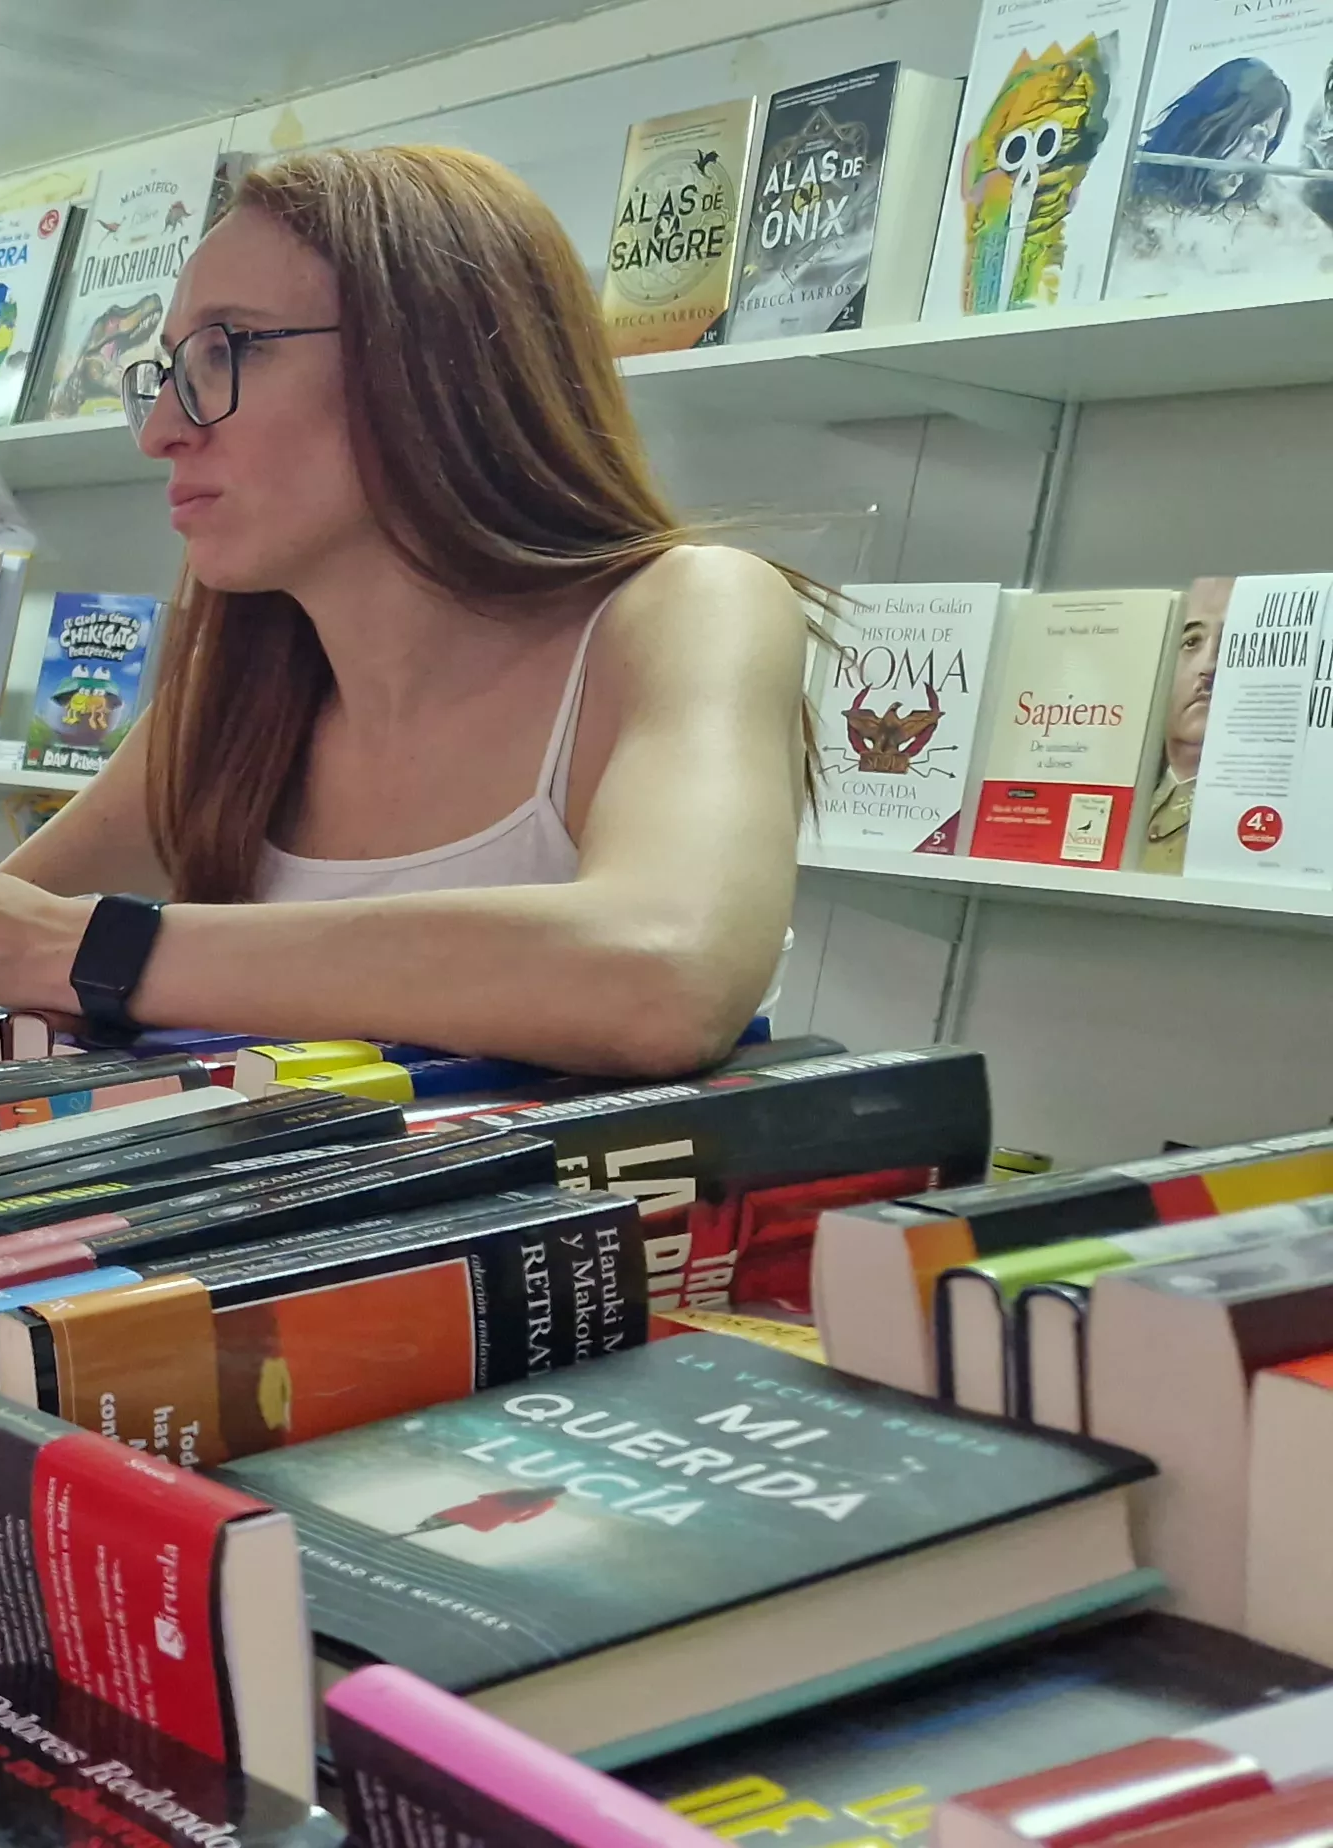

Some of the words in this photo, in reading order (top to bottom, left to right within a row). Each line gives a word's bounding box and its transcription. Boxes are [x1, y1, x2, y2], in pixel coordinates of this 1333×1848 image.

[763, 149, 840, 197] ALAS
[841, 156, 865, 179] DE
[618, 184, 699, 228] ALAS
[700, 192, 724, 212] DE
[761, 195, 849, 250] ÓNIX
[79, 235, 191, 299] DINOSAURIOS
[610, 225, 726, 272] SANGRE
[662, 306, 716, 324] YARROS
[734, 289, 797, 313] REBECCA
[799, 283, 853, 303] YARROS
[851, 599, 883, 617] Juan
[884, 598, 926, 616] Eslava
[929, 597, 974, 615] Galán
[1254, 585, 1321, 628] JULIÁN
[860, 627, 927, 644] HISTORIA
[931, 627, 955, 644] DE
[1225, 630, 1309, 669] CASANOVA
[832, 644, 972, 695] ROMA
[1013, 690, 1125, 739] Sapiens
[1030, 740, 1044, 752] De
[820, 799, 848, 815] ARA
[841, 782, 918, 800] CONTADA
[268, 1170, 396, 1205] SACCOMANNO
[560, 1231, 585, 1252] y
[594, 1226, 626, 1327] Haruki
[153, 1405, 176, 1449] has
[675, 1354, 717, 1372] LA
[734, 1370, 866, 1419] VECINA
[881, 1418, 1001, 1457] RUBIA
[694, 1402, 831, 1451] MI
[460, 1434, 707, 1527] LUCÍA
[502, 1392, 868, 1524] QUERIDA
[154, 1543, 185, 1660] Siruela
[77, 1758, 244, 1848] Redondo
